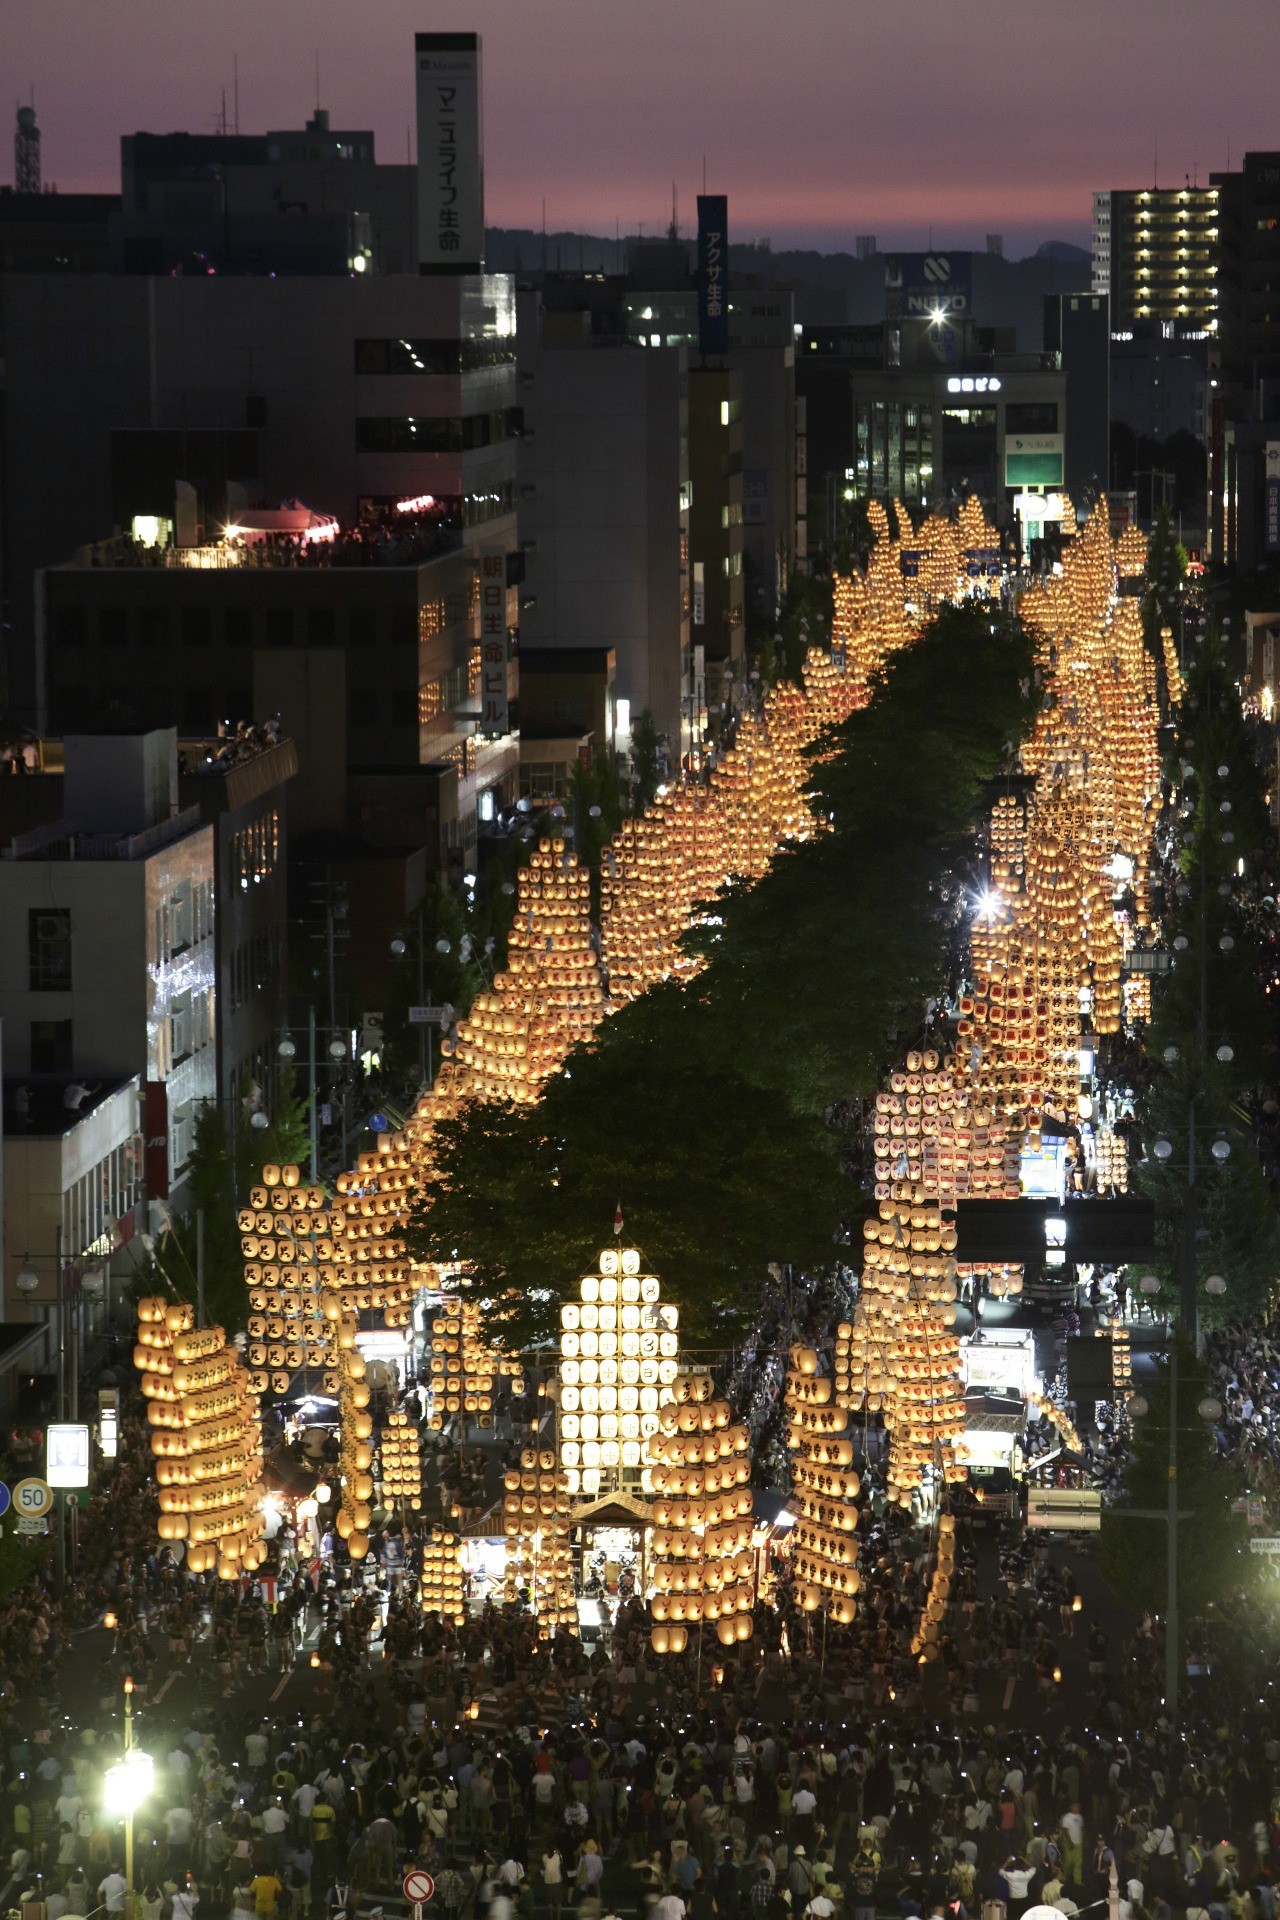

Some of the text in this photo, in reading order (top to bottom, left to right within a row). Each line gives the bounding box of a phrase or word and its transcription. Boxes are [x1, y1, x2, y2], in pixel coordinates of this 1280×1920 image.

[437, 87, 460, 252] マニュライフ生命
[706, 232, 723, 317] アクサ生命
[483, 557, 504, 722] 朝日生命ビル
[22, 1489, 43, 1506] 50
